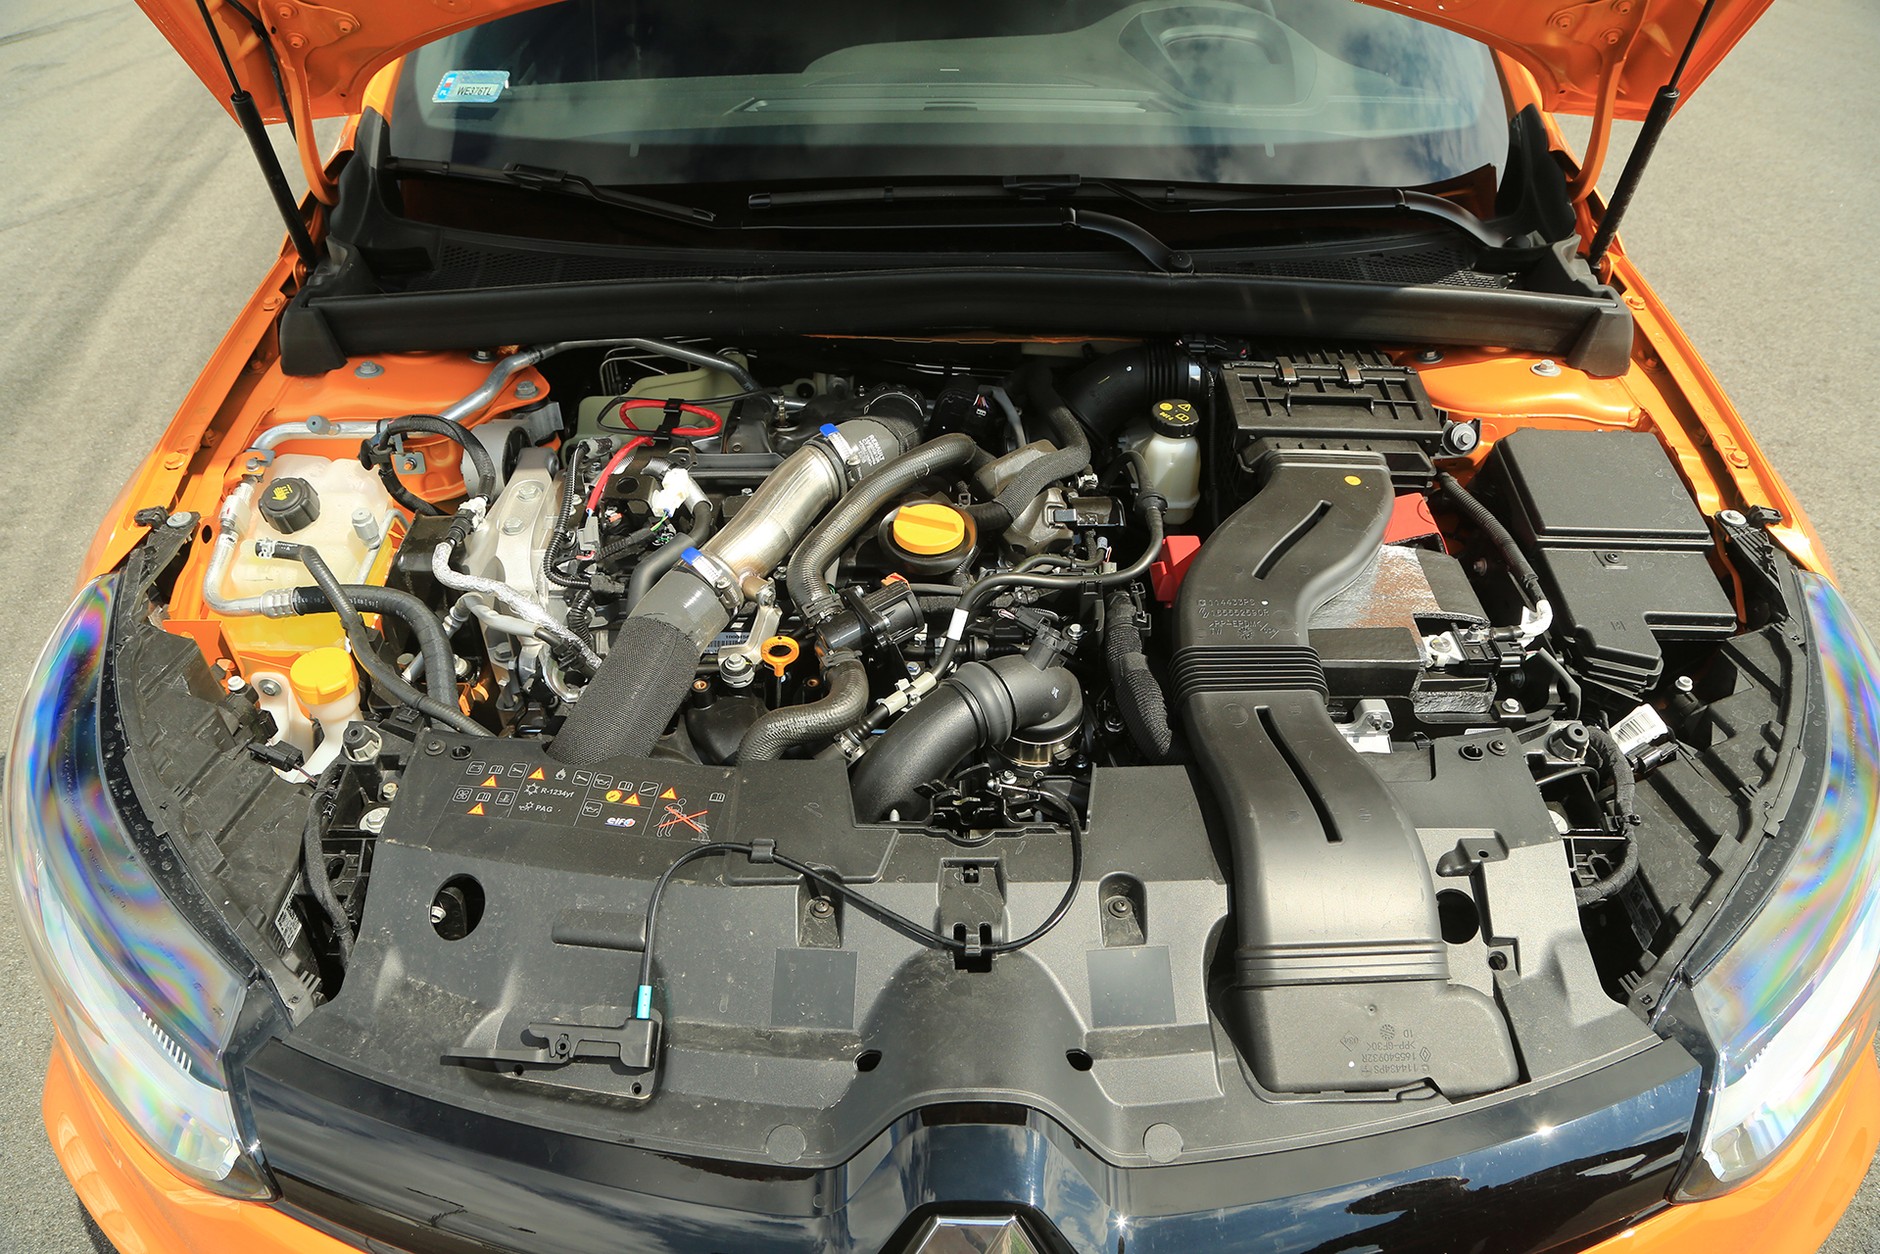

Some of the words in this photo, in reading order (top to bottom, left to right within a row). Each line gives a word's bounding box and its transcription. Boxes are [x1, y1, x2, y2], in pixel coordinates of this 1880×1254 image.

[456, 86, 493, 96] WE376TL
[540, 787, 575, 798] R-1234yf
[534, 804, 553, 813] PAG
[1361, 1052, 1416, 1063] 165540932R
[1373, 1063, 1417, 1073] 114434PS
